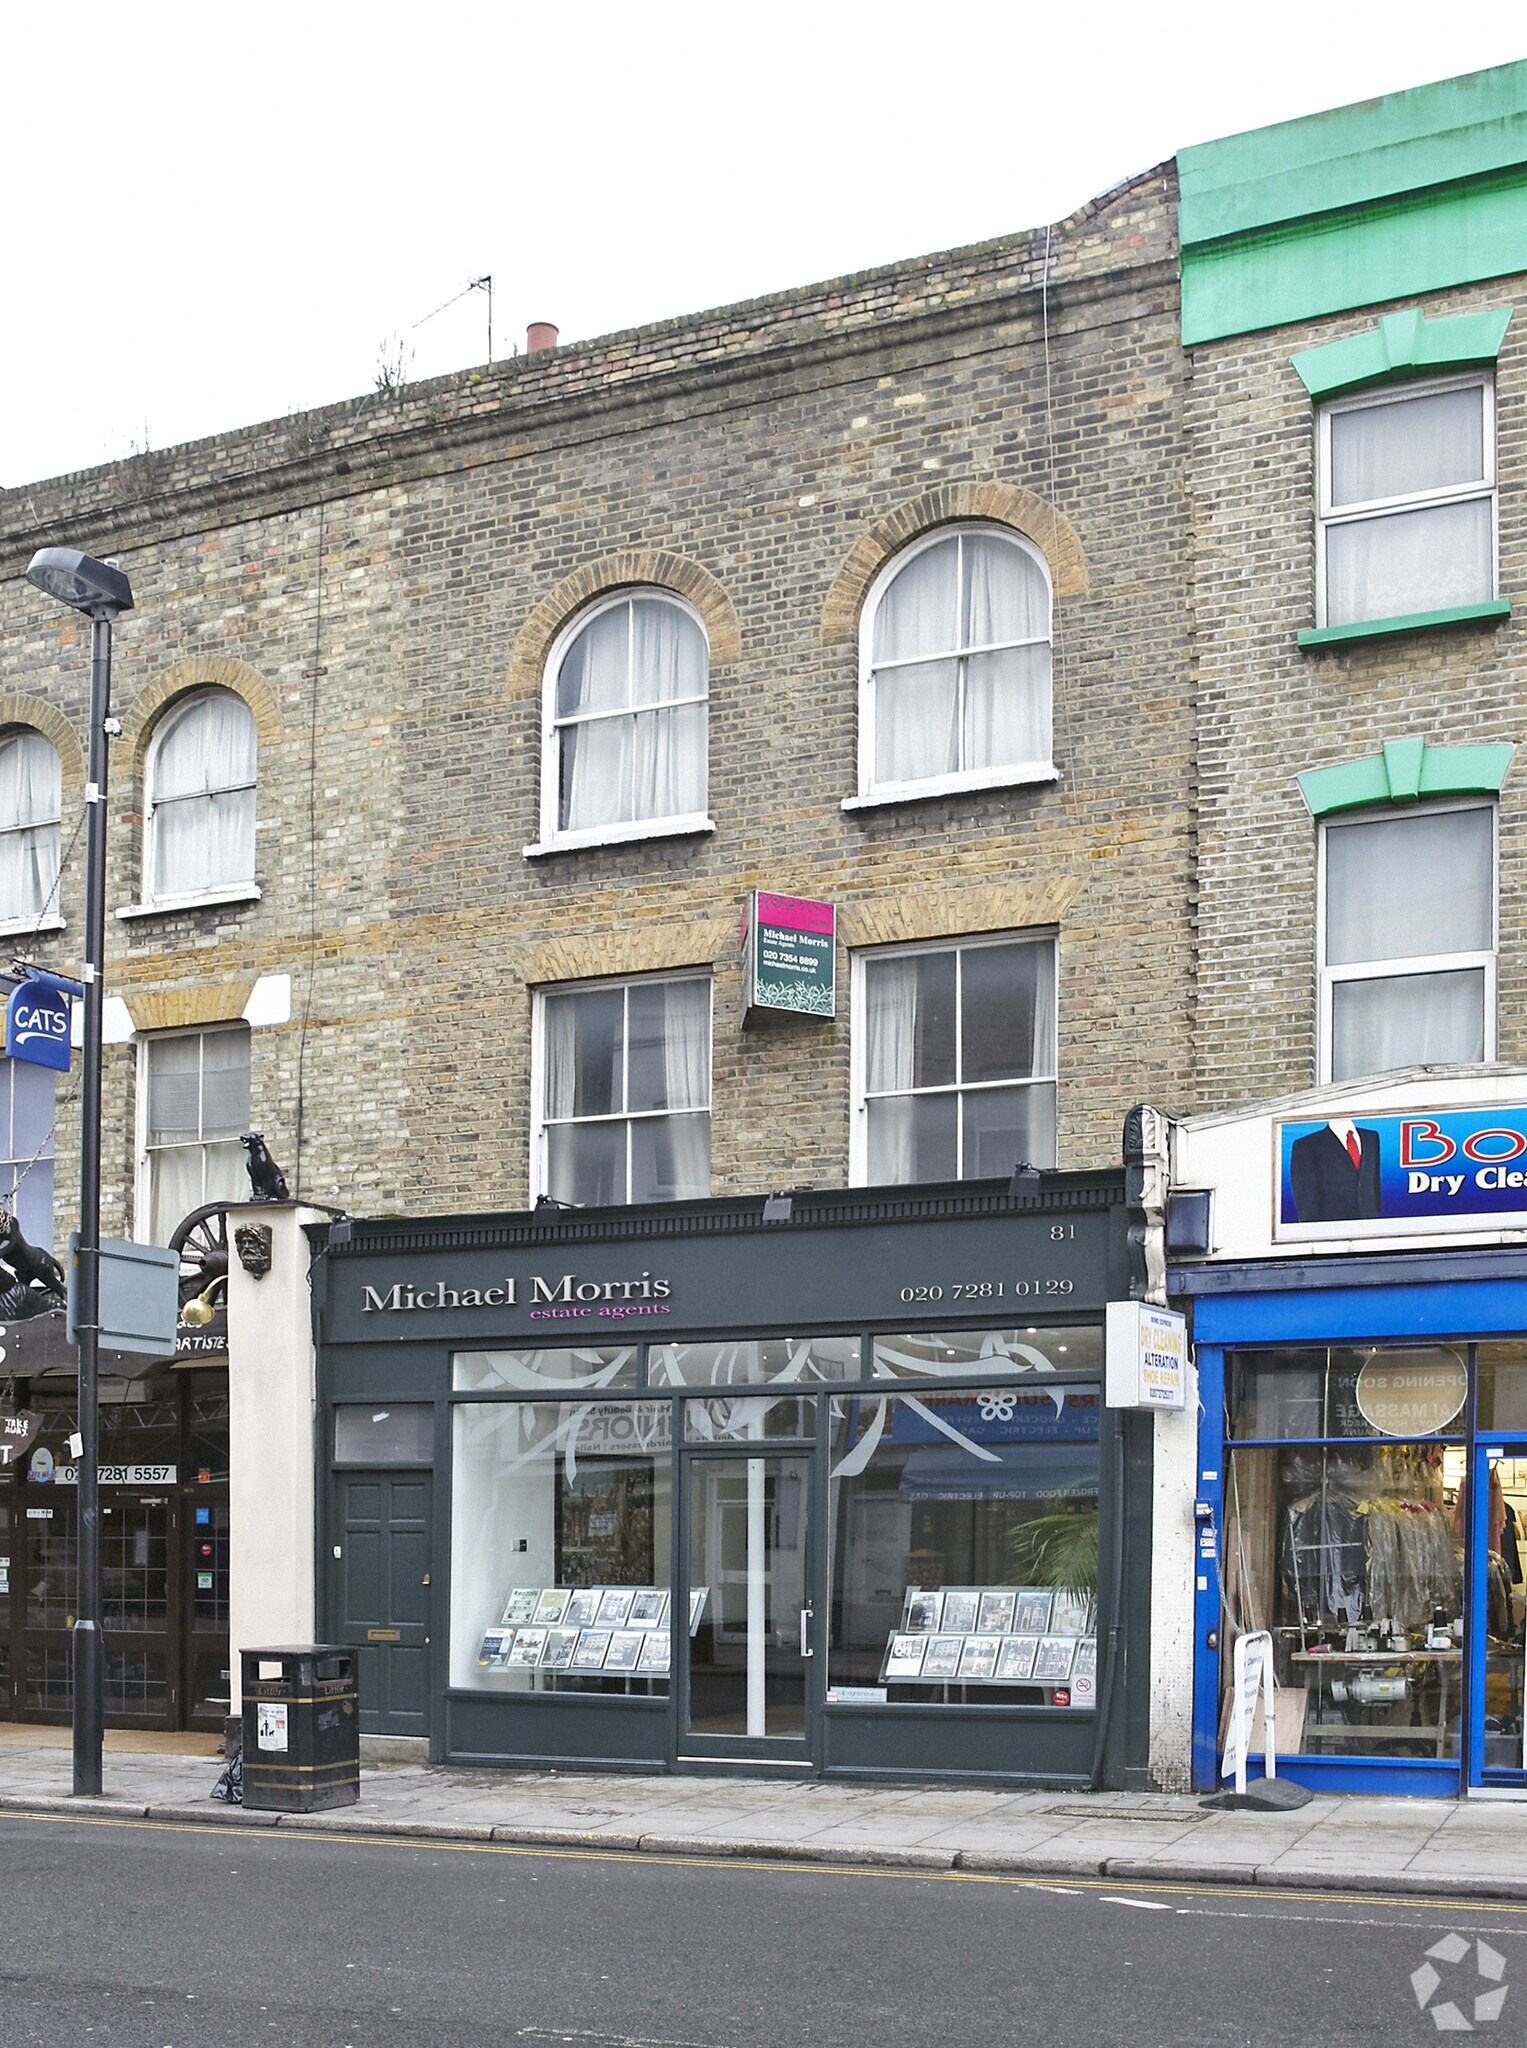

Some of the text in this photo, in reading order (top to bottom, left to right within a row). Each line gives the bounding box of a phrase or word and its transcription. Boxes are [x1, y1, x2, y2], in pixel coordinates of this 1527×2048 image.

[763, 928, 829, 948] Michael Morris
[763, 950, 778, 960] 020
[779, 952, 798, 963] 7354
[15, 1006, 67, 1034] CATS
[1408, 1166, 1527, 1196] Dry Cle
[1049, 1224, 1076, 1242] 81
[361, 1271, 671, 1312] Michael Morris
[900, 1279, 1074, 1303] 020 7281 0129
[529, 1303, 671, 1321] estate agents
[1144, 1352, 1179, 1371] ALTERATION
[5, 1418, 28, 1429] TAKE
[98, 1467, 128, 1481] 7281
[134, 1467, 169, 1480] 5557
